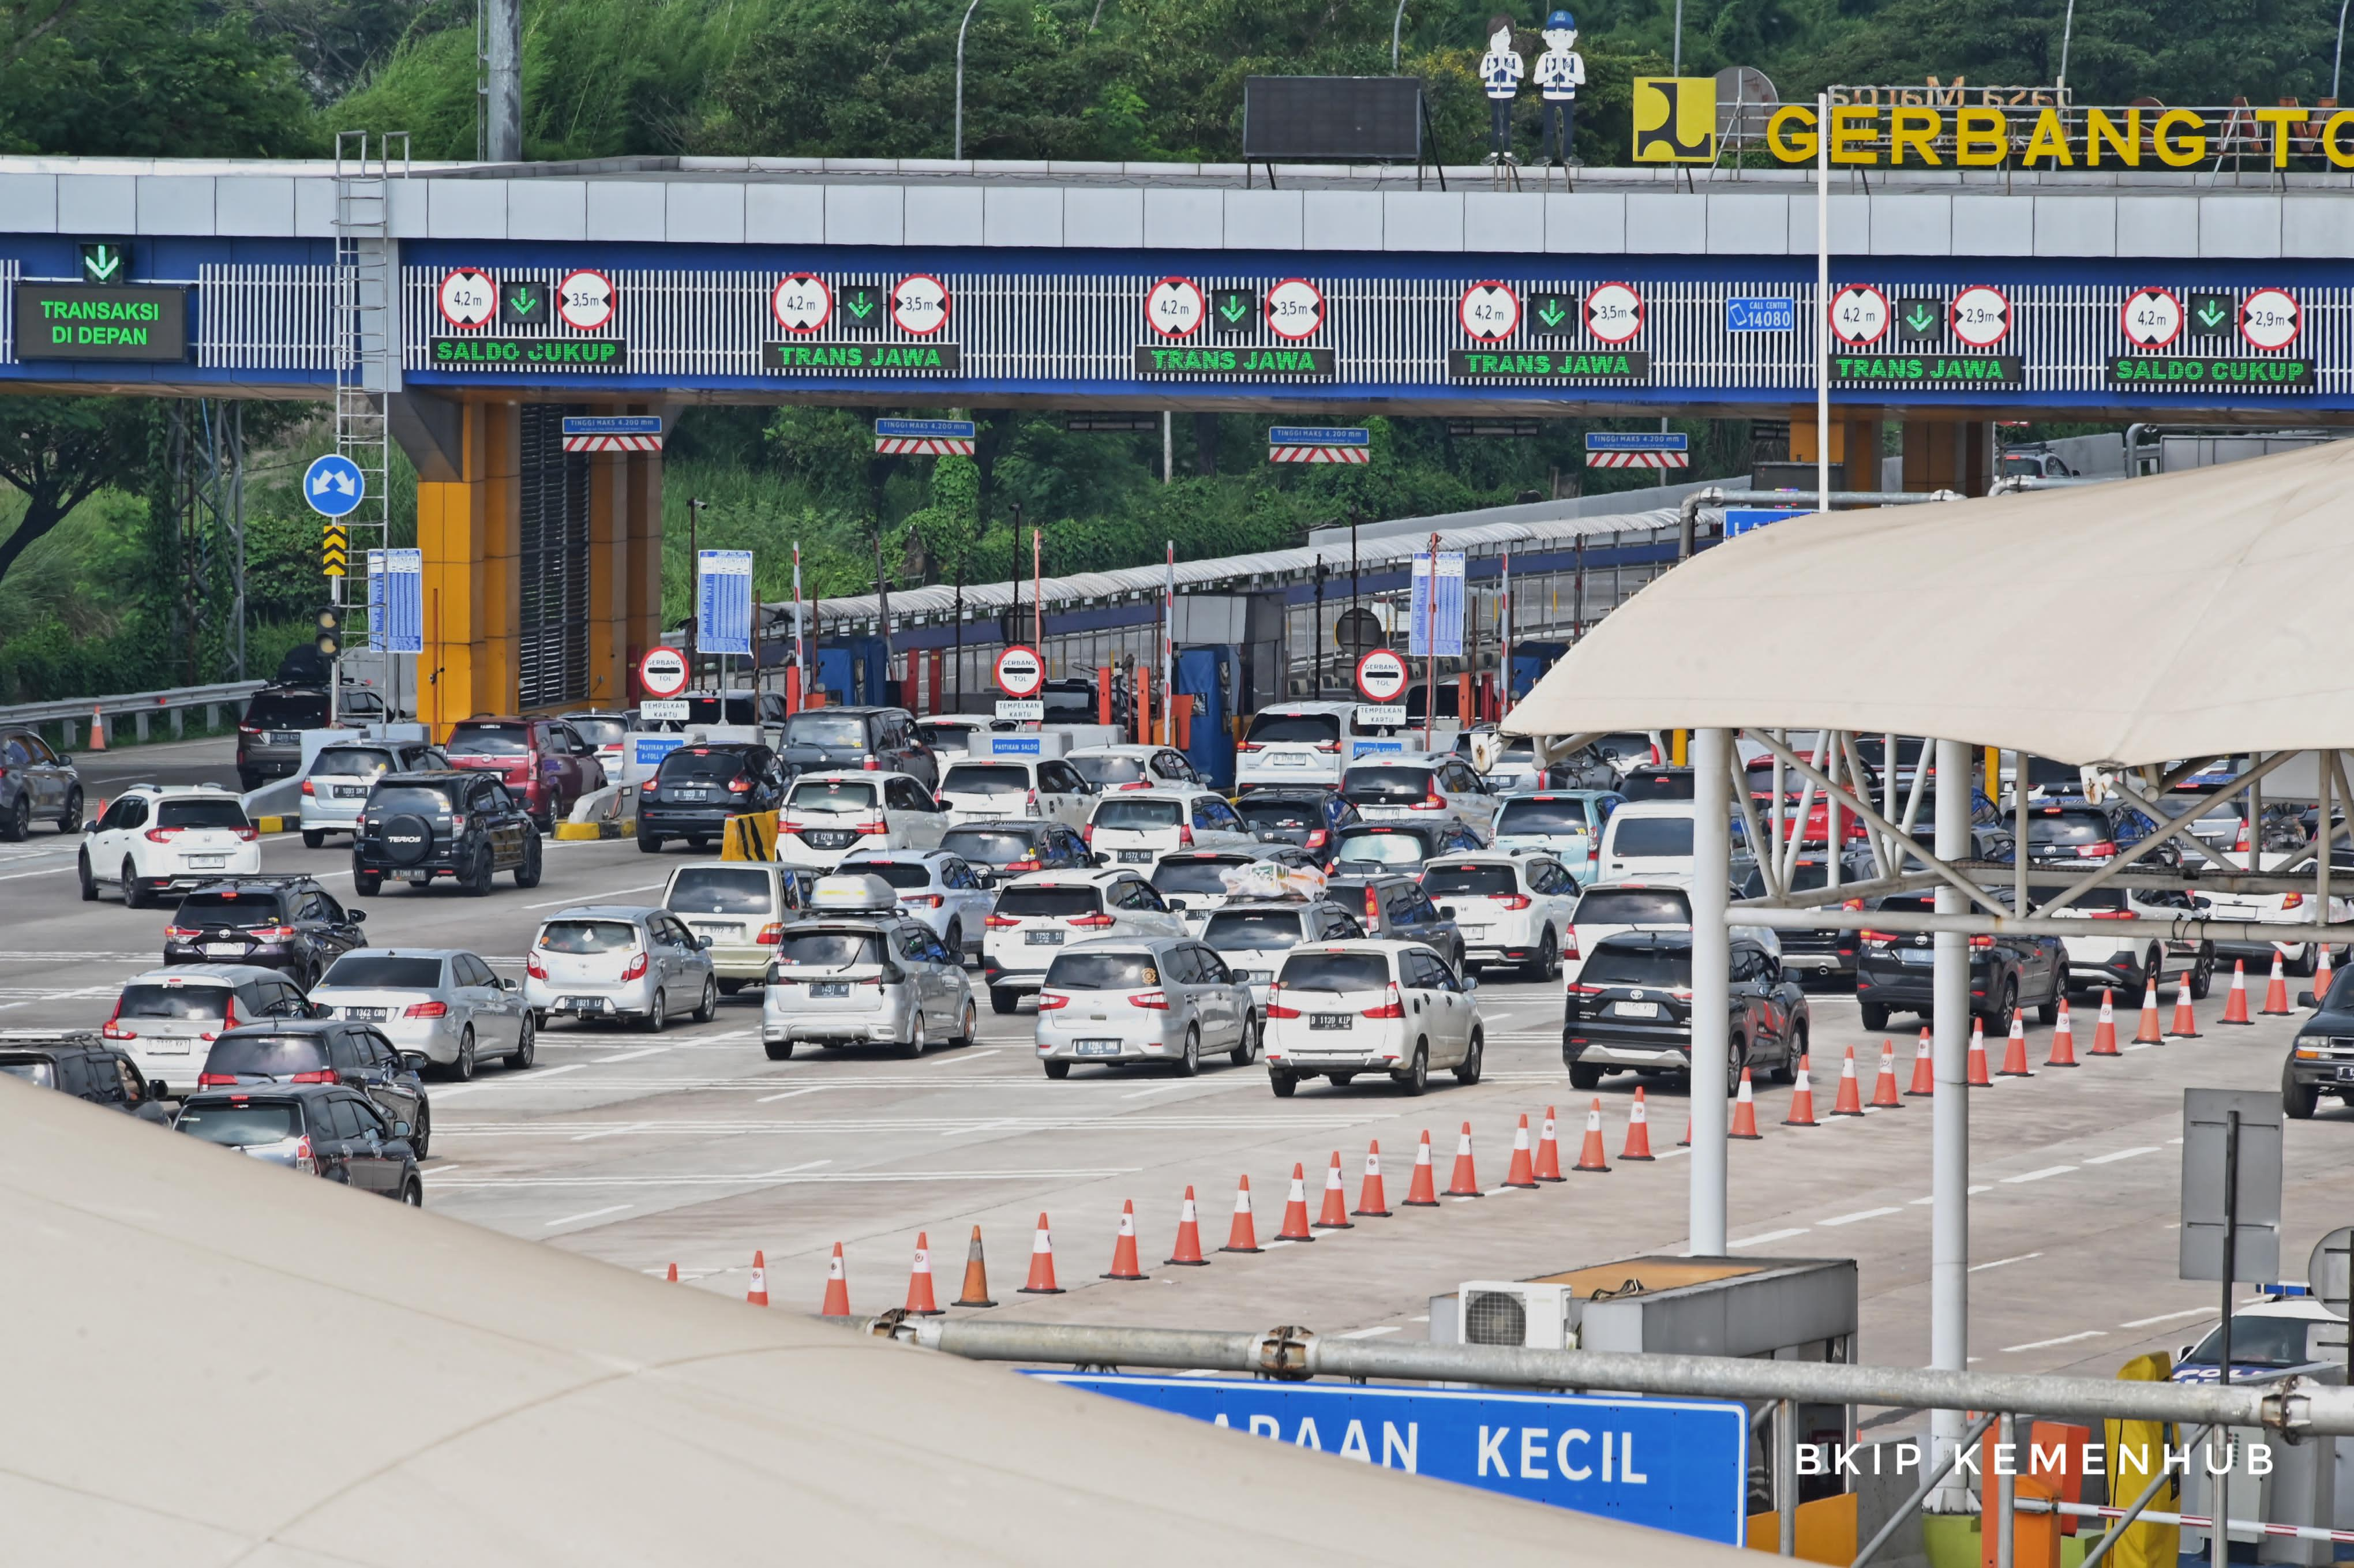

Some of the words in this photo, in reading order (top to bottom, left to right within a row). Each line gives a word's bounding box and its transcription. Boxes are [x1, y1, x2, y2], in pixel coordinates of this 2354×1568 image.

[1768, 106, 2205, 167] GERBANG
[41, 301, 159, 321] TRANSAKSI
[1749, 301, 1763, 310] CALL
[1764, 302, 1787, 310] CENTER
[1748, 311, 1790, 327] 14080
[53, 325, 72, 344] DI
[78, 326, 147, 345] DEPAN
[437, 342, 519, 361] SALDO
[528, 343, 616, 362] CUKUP
[779, 347, 863, 366] TRANS
[869, 348, 942, 367] JAWA
[1152, 349, 1236, 370] TRANS
[1243, 351, 1315, 370] JAWA
[1464, 355, 1551, 374] TRANS
[1558, 355, 1630, 374] JAWA
[1836, 359, 1923, 379] TRANS
[1930, 359, 2003, 379] JAWA
[2116, 361, 2204, 380] SALDO
[2211, 362, 2304, 381] CUKUP
[1311, 1015, 1315, 1024] B
[1478, 1426, 1647, 1484] KECIL
